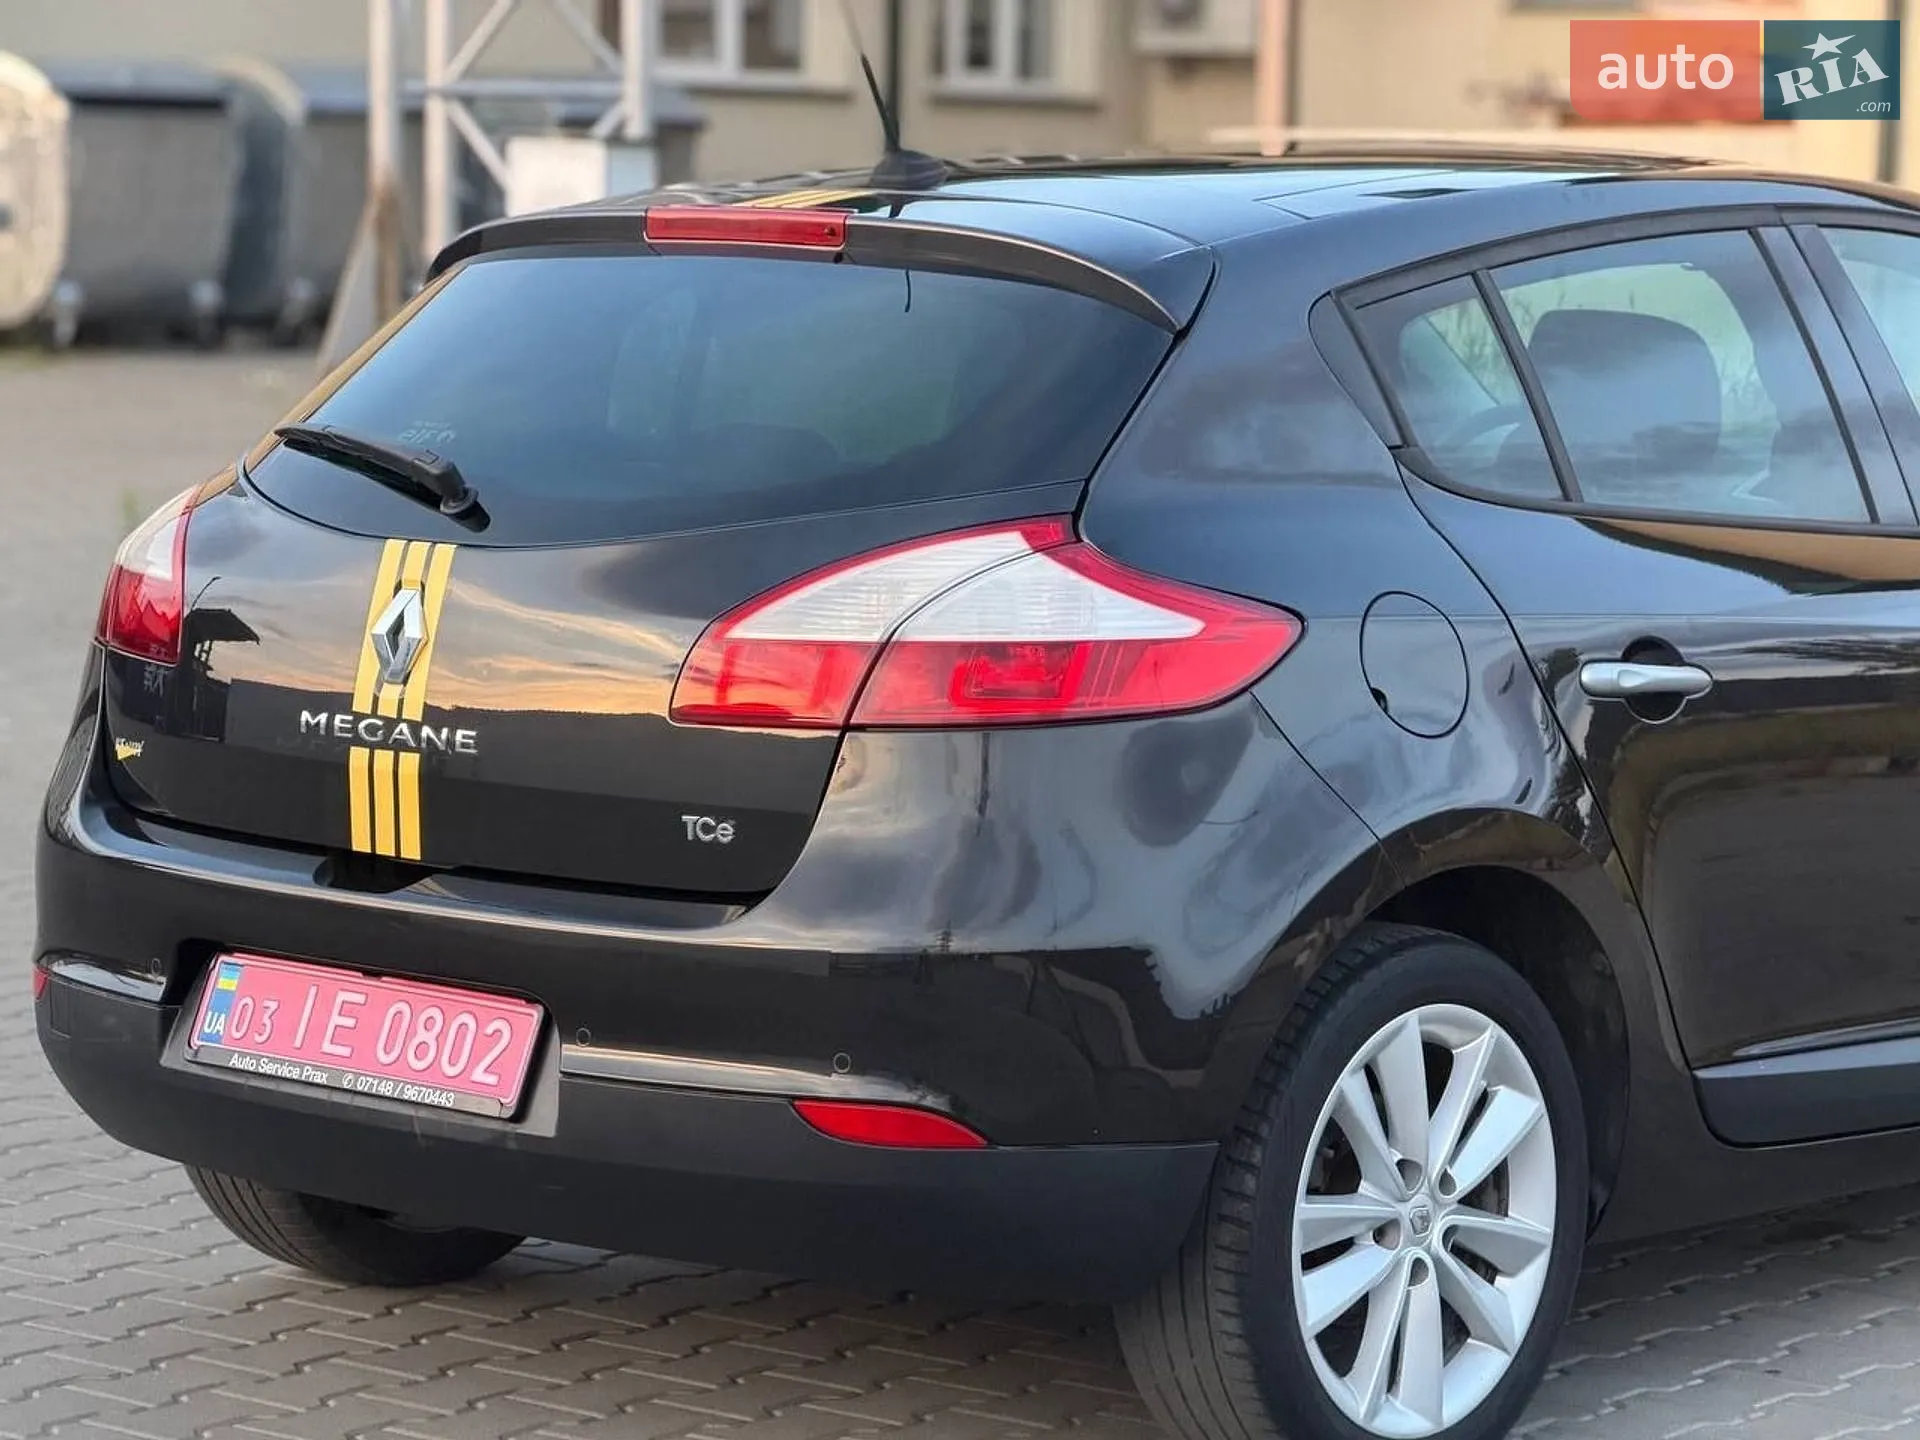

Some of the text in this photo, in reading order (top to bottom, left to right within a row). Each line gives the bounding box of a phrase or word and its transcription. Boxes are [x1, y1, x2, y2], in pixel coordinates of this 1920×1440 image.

[300, 710, 479, 754] MEGANE
[681, 815, 735, 844] TCe
[203, 1011, 226, 1035] UA
[231, 984, 513, 1086] 03 IE 0802
[228, 1052, 455, 1107] Auto Service Prax 07148 / 9670443
